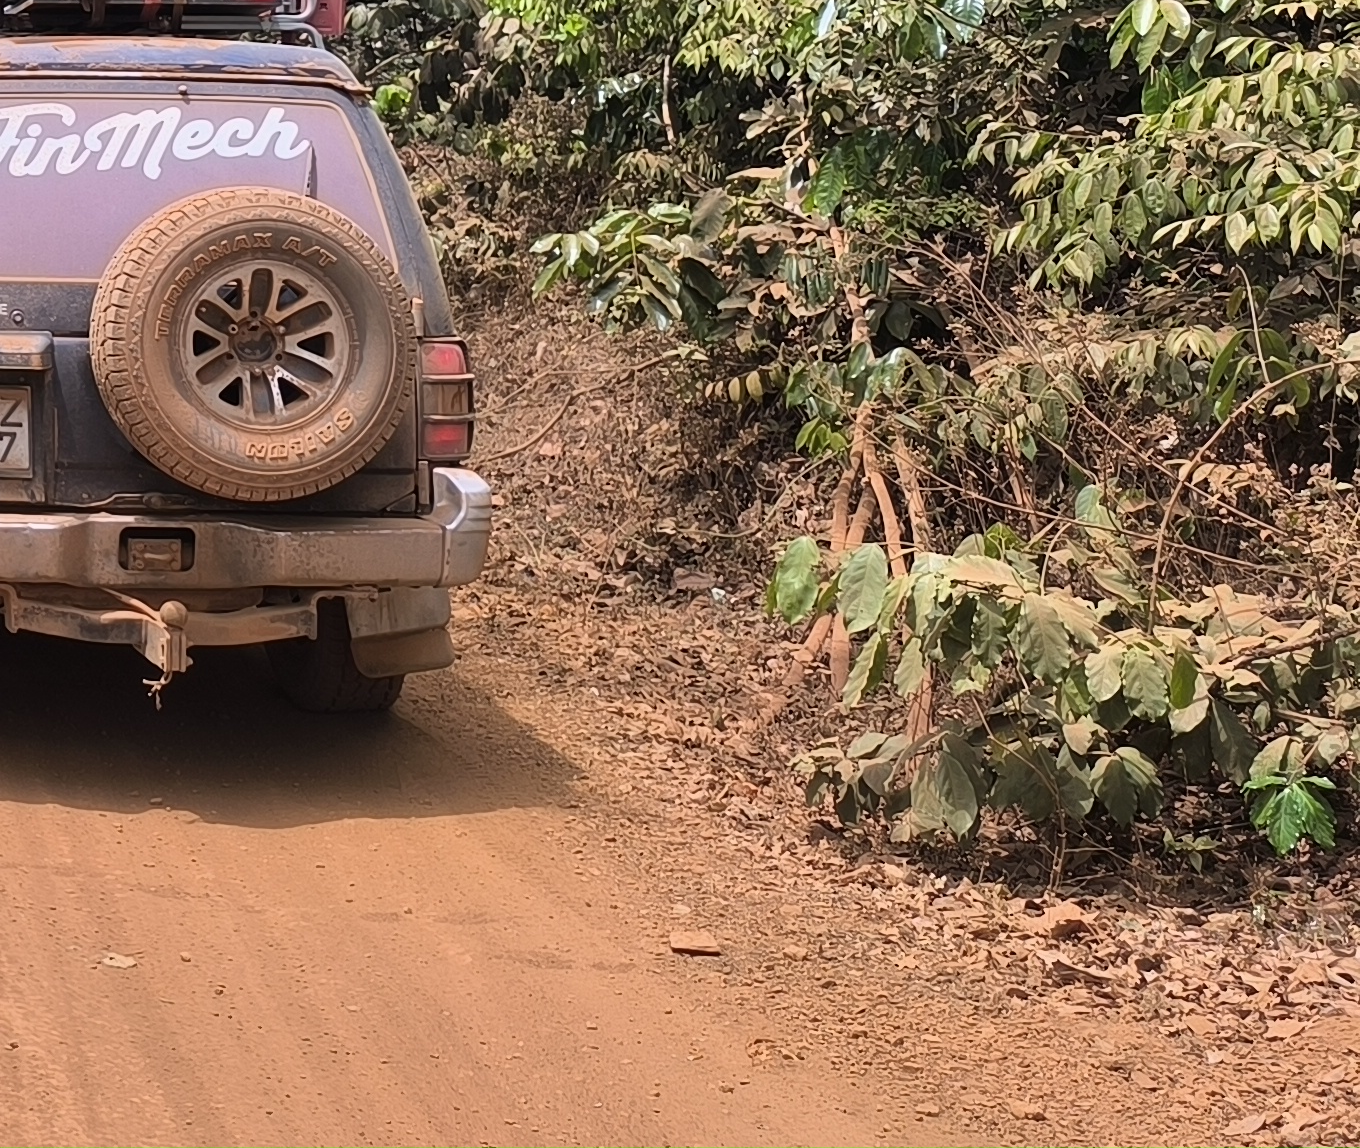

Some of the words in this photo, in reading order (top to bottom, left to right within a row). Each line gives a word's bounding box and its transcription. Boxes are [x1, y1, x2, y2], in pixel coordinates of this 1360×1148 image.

[155, 232, 273, 341] TERRAMAX
[282, 235, 338, 268] A/T
[245, 407, 355, 460] SAILUN
